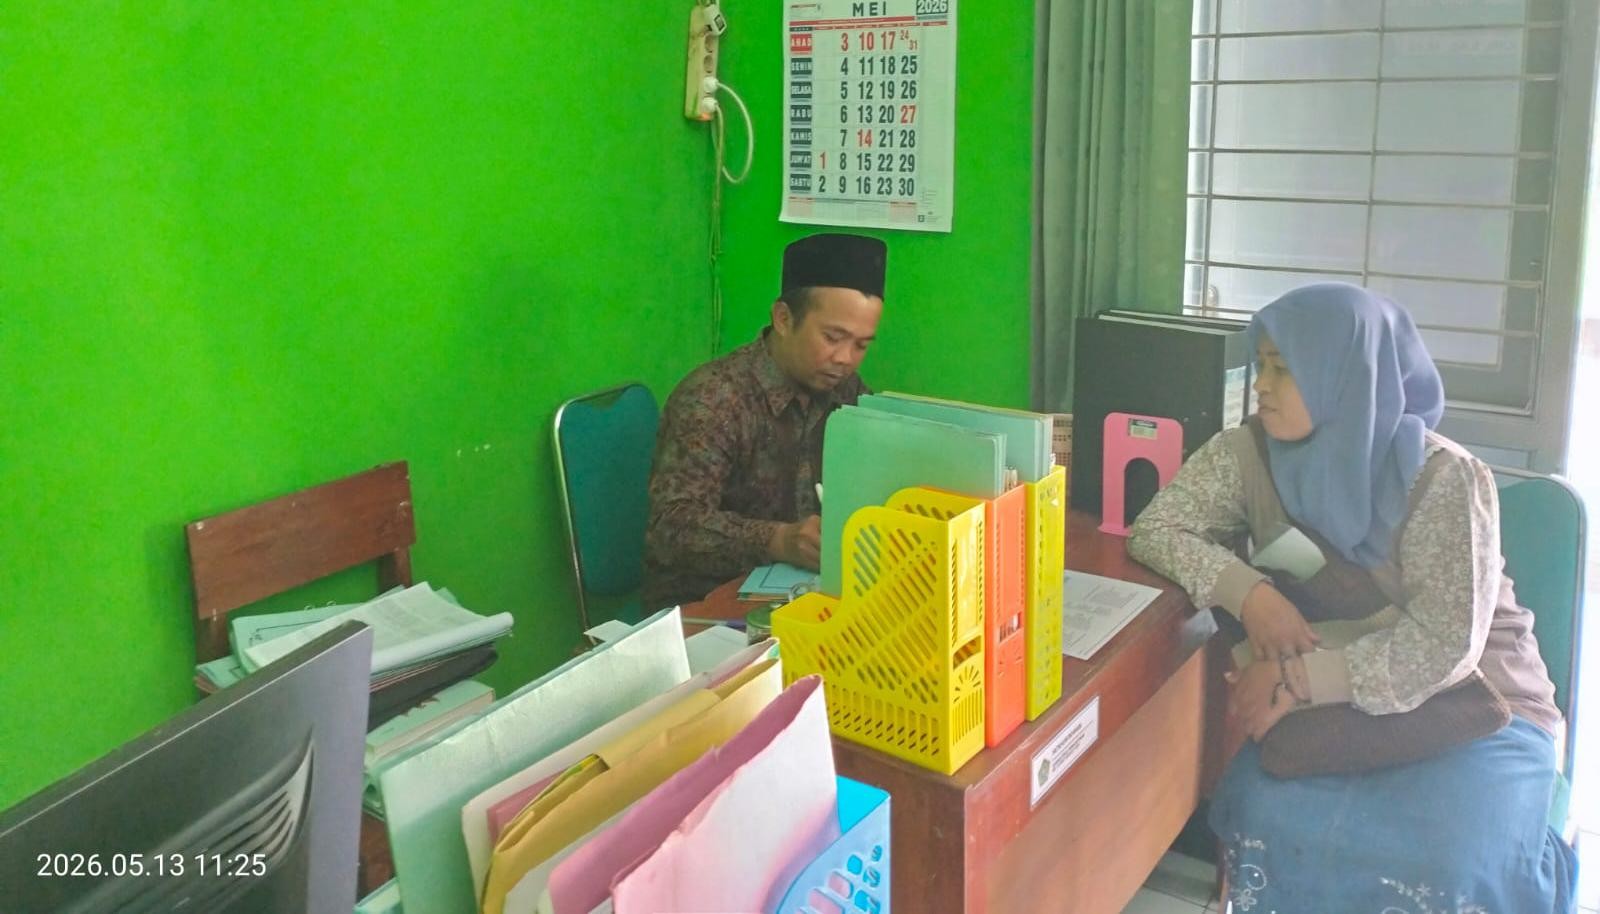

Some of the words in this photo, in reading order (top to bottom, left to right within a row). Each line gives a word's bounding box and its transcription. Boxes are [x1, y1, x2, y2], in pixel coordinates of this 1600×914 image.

[852, 2, 887, 17] MEI
[916, 0, 948, 14] 2026
[841, 33, 849, 51] 3
[859, 32, 874, 50] 10
[881, 31, 896, 50] 17
[900, 30, 909, 40] 24
[909, 40, 918, 50] 31
[841, 57, 848, 75] 4
[859, 56, 874, 75] 11
[880, 56, 896, 75] 18
[901, 55, 918, 74] 25
[841, 81, 848, 99] 5
[858, 81, 873, 99] 12
[880, 81, 895, 99] 19
[901, 80, 917, 99] 26
[840, 105, 848, 123] 6
[858, 105, 873, 123] 13
[879, 105, 895, 123] 20
[901, 105, 916, 123] 27
[840, 130, 848, 147] 7
[858, 129, 873, 147] 14
[879, 129, 894, 147] 21
[900, 130, 916, 148] 28
[820, 152, 826, 169] 1
[840, 153, 847, 170] 8
[857, 153, 872, 171] 15
[878, 154, 893, 172] 22
[900, 154, 915, 172] 29
[819, 175, 826, 192] 2
[839, 176, 846, 193] 9
[856, 176, 871, 194] 16
[877, 177, 893, 195] 23
[899, 178, 914, 196] 30
